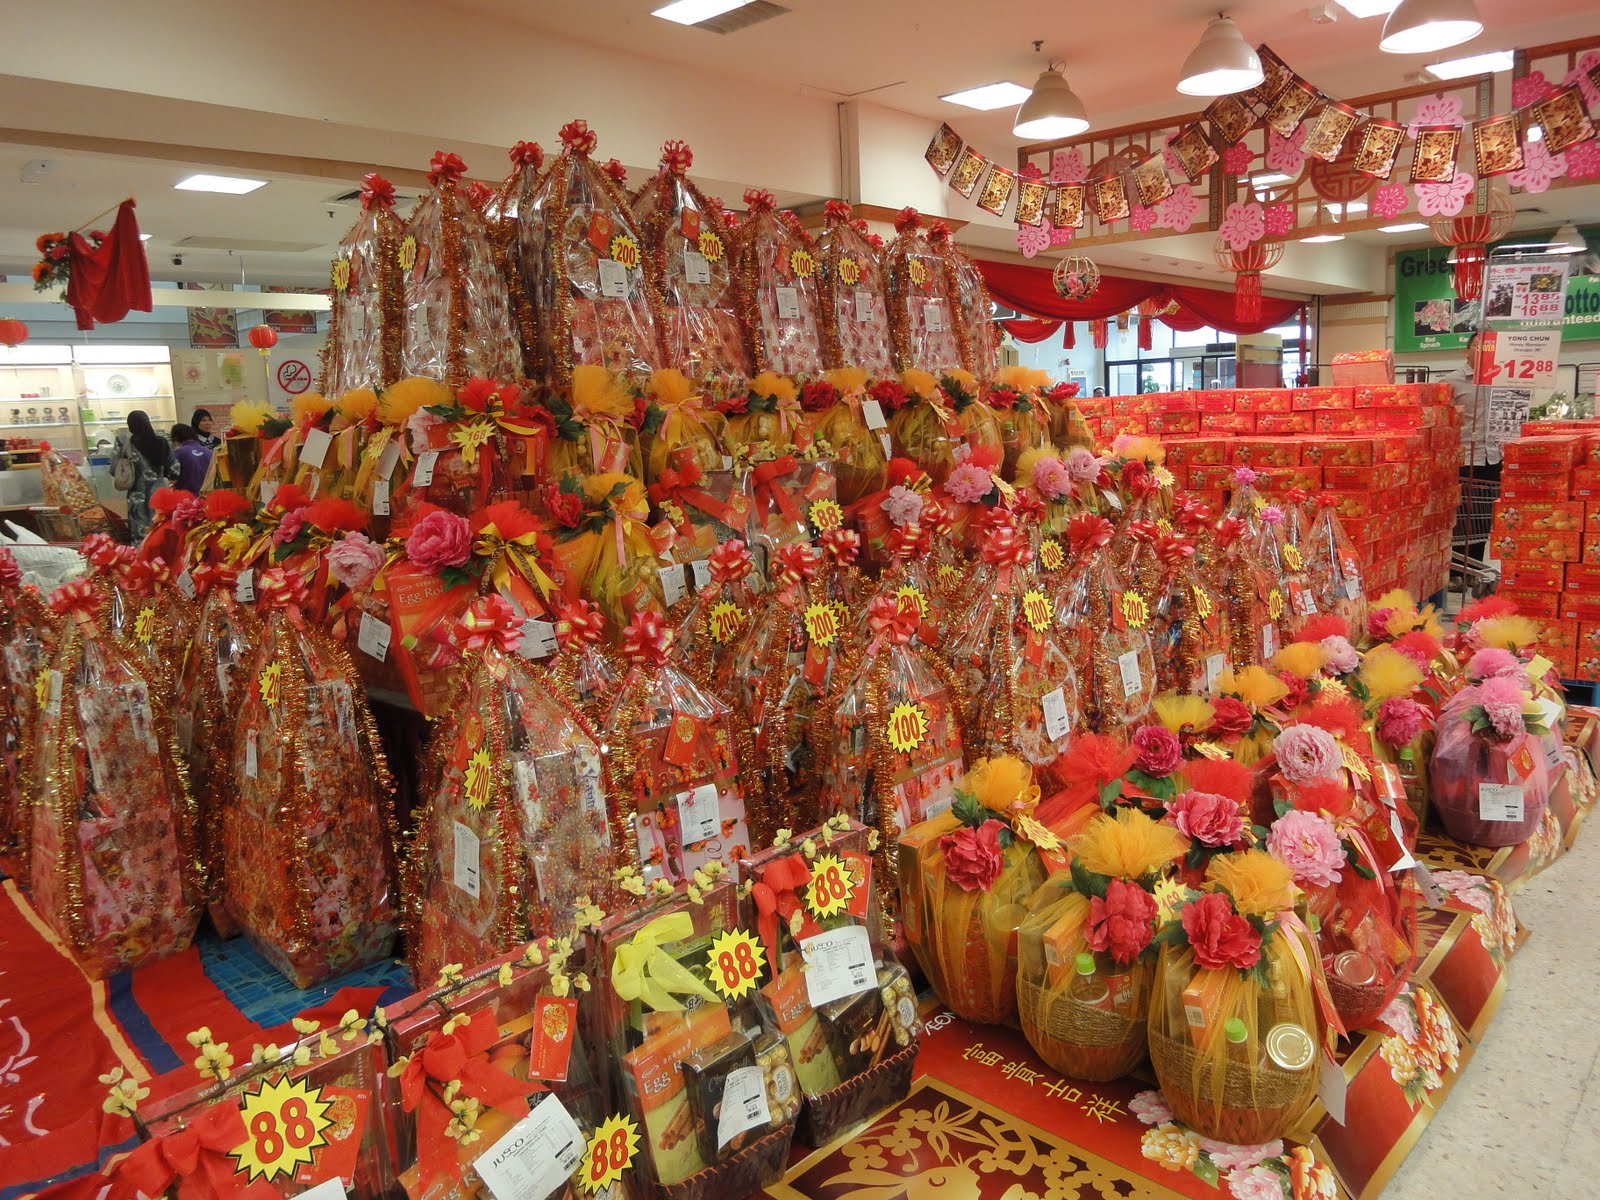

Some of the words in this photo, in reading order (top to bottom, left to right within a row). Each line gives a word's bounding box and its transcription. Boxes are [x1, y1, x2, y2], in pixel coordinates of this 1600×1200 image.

[616, 242, 636, 265] 200
[703, 239, 720, 257] 200
[795, 256, 811, 274] 100
[841, 264, 856, 277] 100
[911, 264, 923, 277] 100
[1401, 256, 1456, 278] Gree
[1564, 287, 1600, 315] otto
[467, 429, 487, 441] 168
[815, 505, 839, 527] 88
[1043, 544, 1062, 567] 200
[399, 592, 422, 605] Egg
[1028, 600, 1048, 625] 200
[1127, 601, 1143, 623] 200
[716, 609, 739, 641] 200
[810, 611, 834, 641] 200
[894, 711, 921, 745] 100
[469, 761, 489, 802] 200
[814, 865, 847, 908] 88
[718, 941, 757, 989] 88
[782, 1000, 806, 1022] Egg
[643, 1071, 671, 1095] Egg
[250, 1096, 316, 1165] 88
[492, 1137, 524, 1168] JUSCO
[590, 1127, 629, 1182] 88
